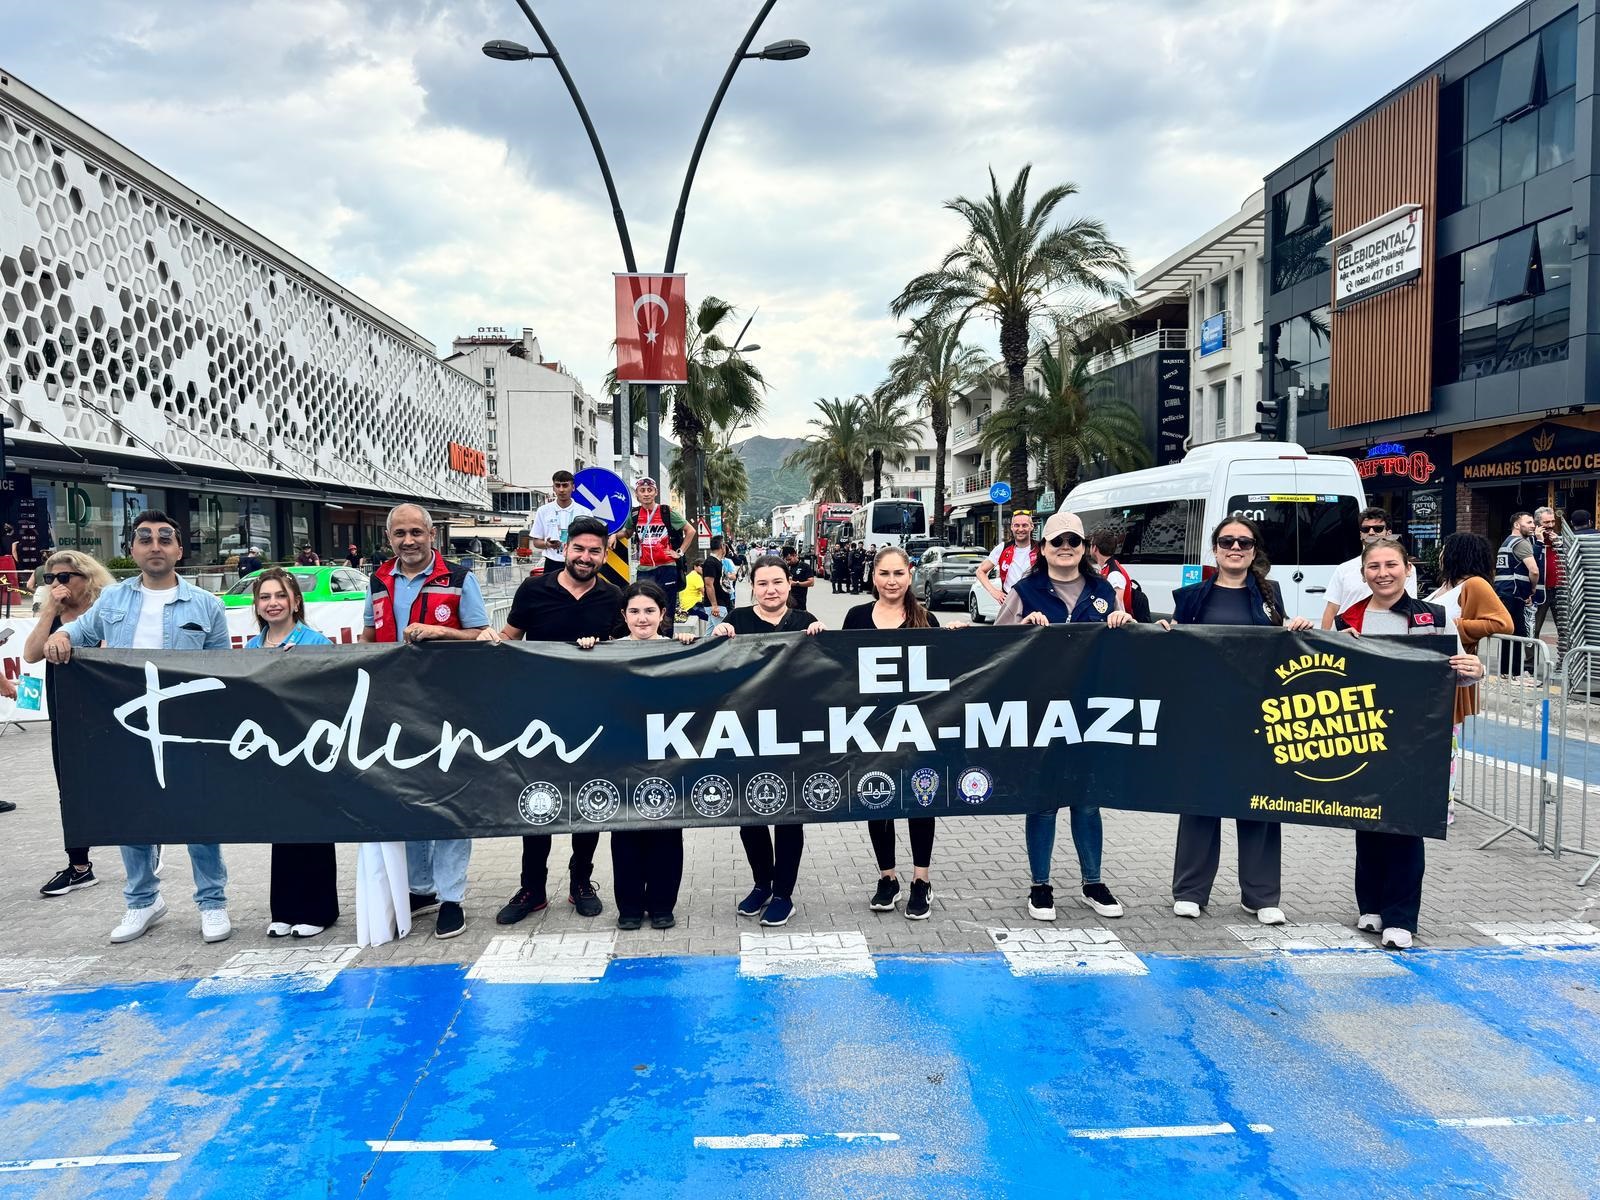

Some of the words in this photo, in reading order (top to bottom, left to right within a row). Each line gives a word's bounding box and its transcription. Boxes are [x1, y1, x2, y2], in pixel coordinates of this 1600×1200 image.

[1337, 230, 1408, 271] CELEBIDENTAL
[1405, 223, 1416, 252] 2
[1371, 269, 1384, 282] 477
[1385, 264, 1394, 276] 61
[1395, 260, 1404, 272] 51
[1355, 450, 1435, 484] ATTOO
[1524, 455, 1582, 474] TOBACCO
[58, 536, 103, 547] DEICMANN
[858, 644, 951, 694] EL
[1274, 653, 1347, 680] KADINA
[645, 696, 1162, 760] KAL-KA-MAZ!
[1273, 731, 1388, 765] SUÇUDUR
